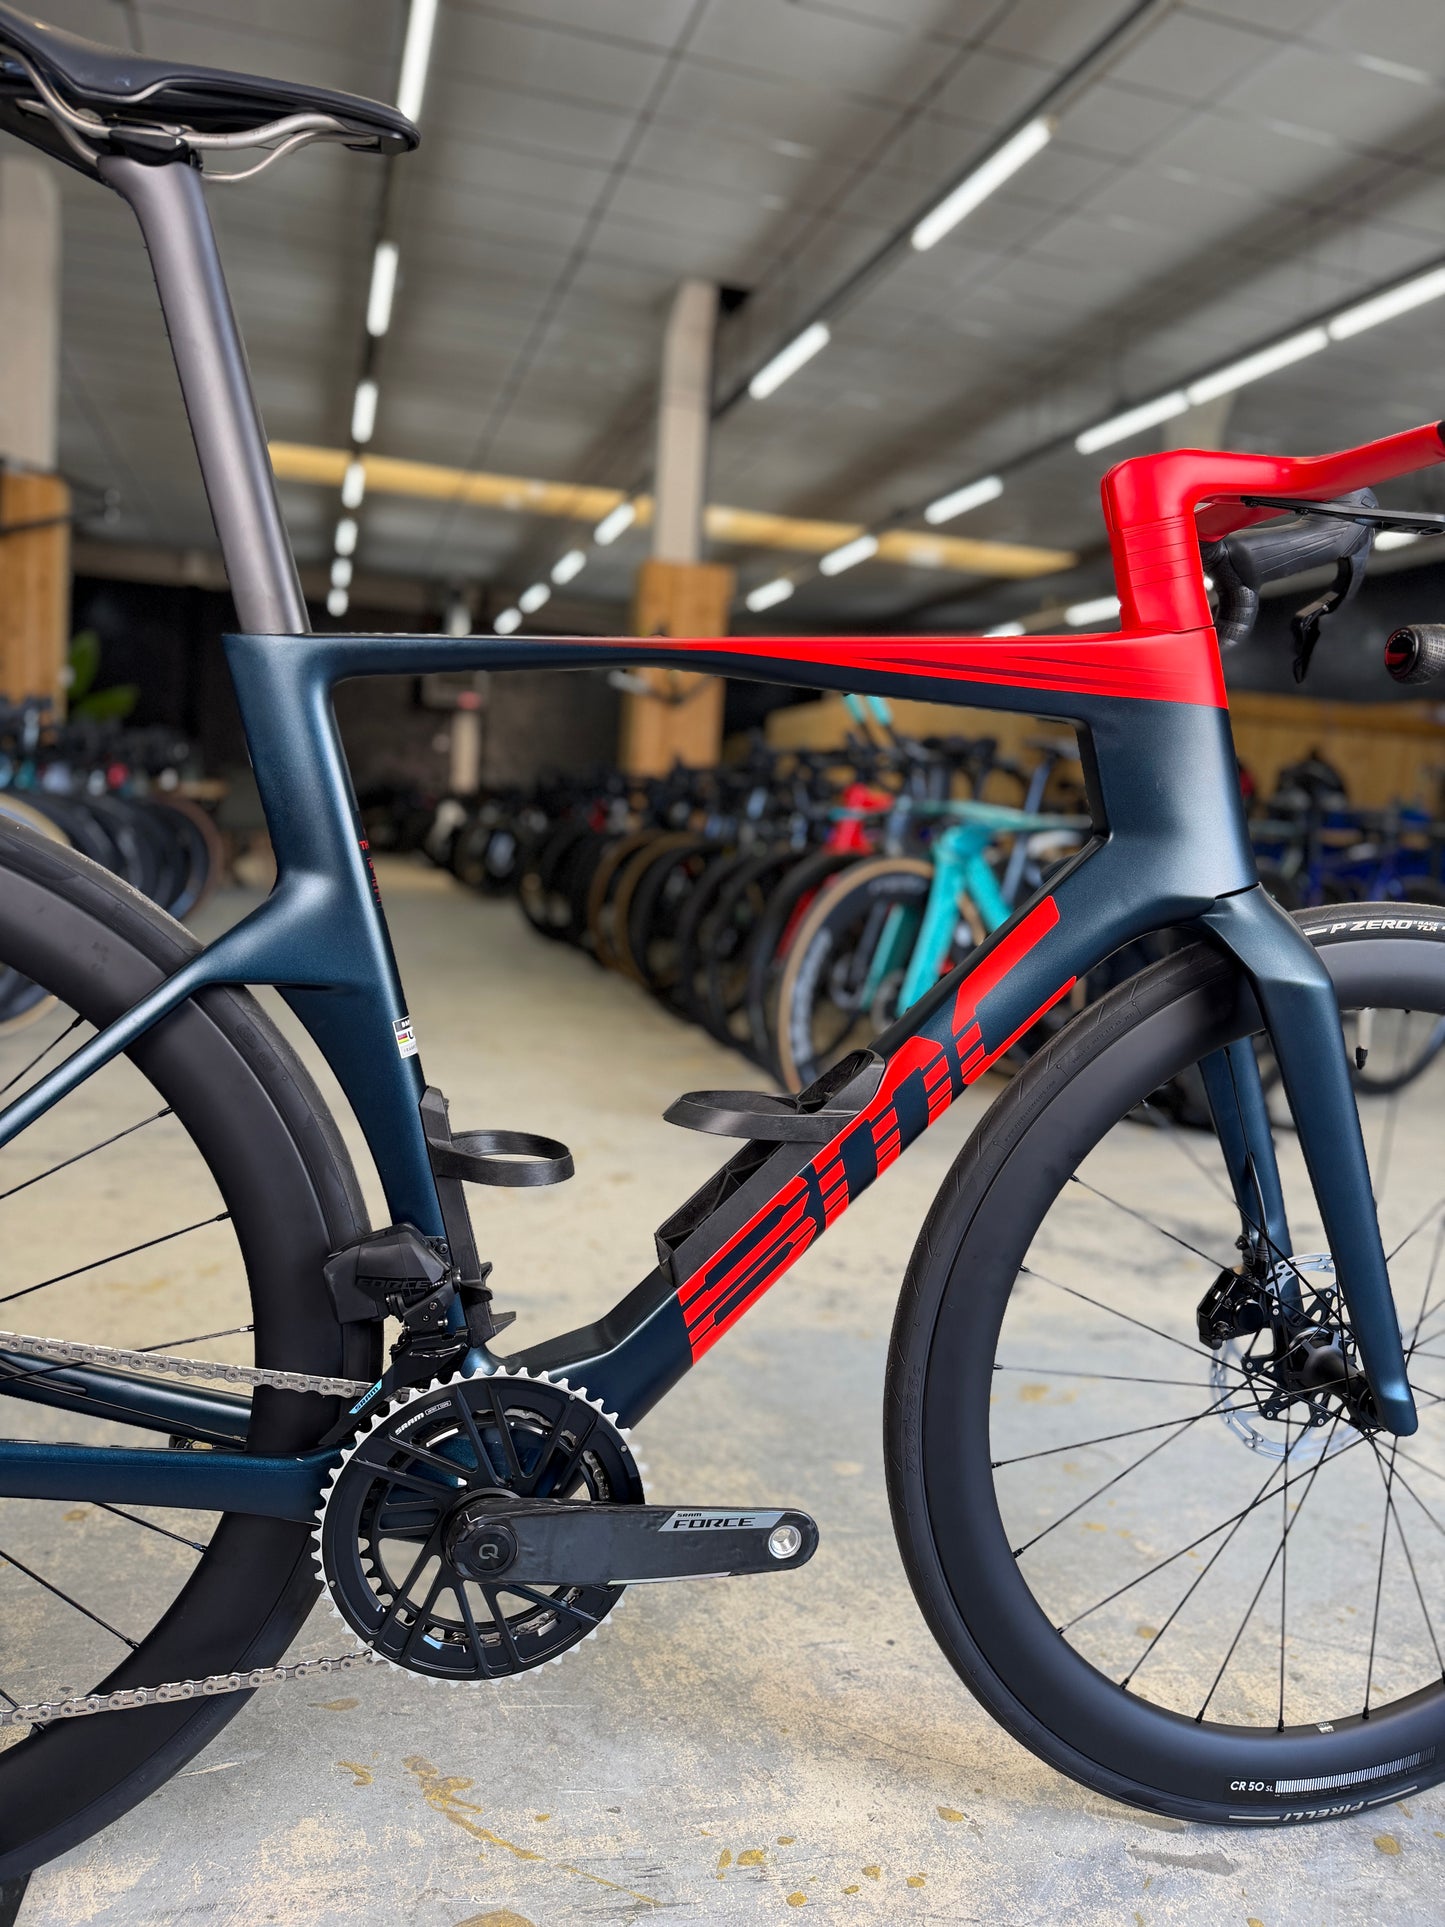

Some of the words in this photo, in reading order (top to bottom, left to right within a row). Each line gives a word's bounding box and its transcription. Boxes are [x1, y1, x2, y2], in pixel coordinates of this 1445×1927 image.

[1330, 922, 1346, 934] P
[1349, 919, 1414, 931] ZERO
[357, 1279, 431, 1290] FORCE
[354, 1385, 380, 1410] SRAM
[394, 1412, 425, 1436] SRAM
[673, 1517, 756, 1529] FORCE
[1282, 1801, 1365, 1822] PIRELLI
